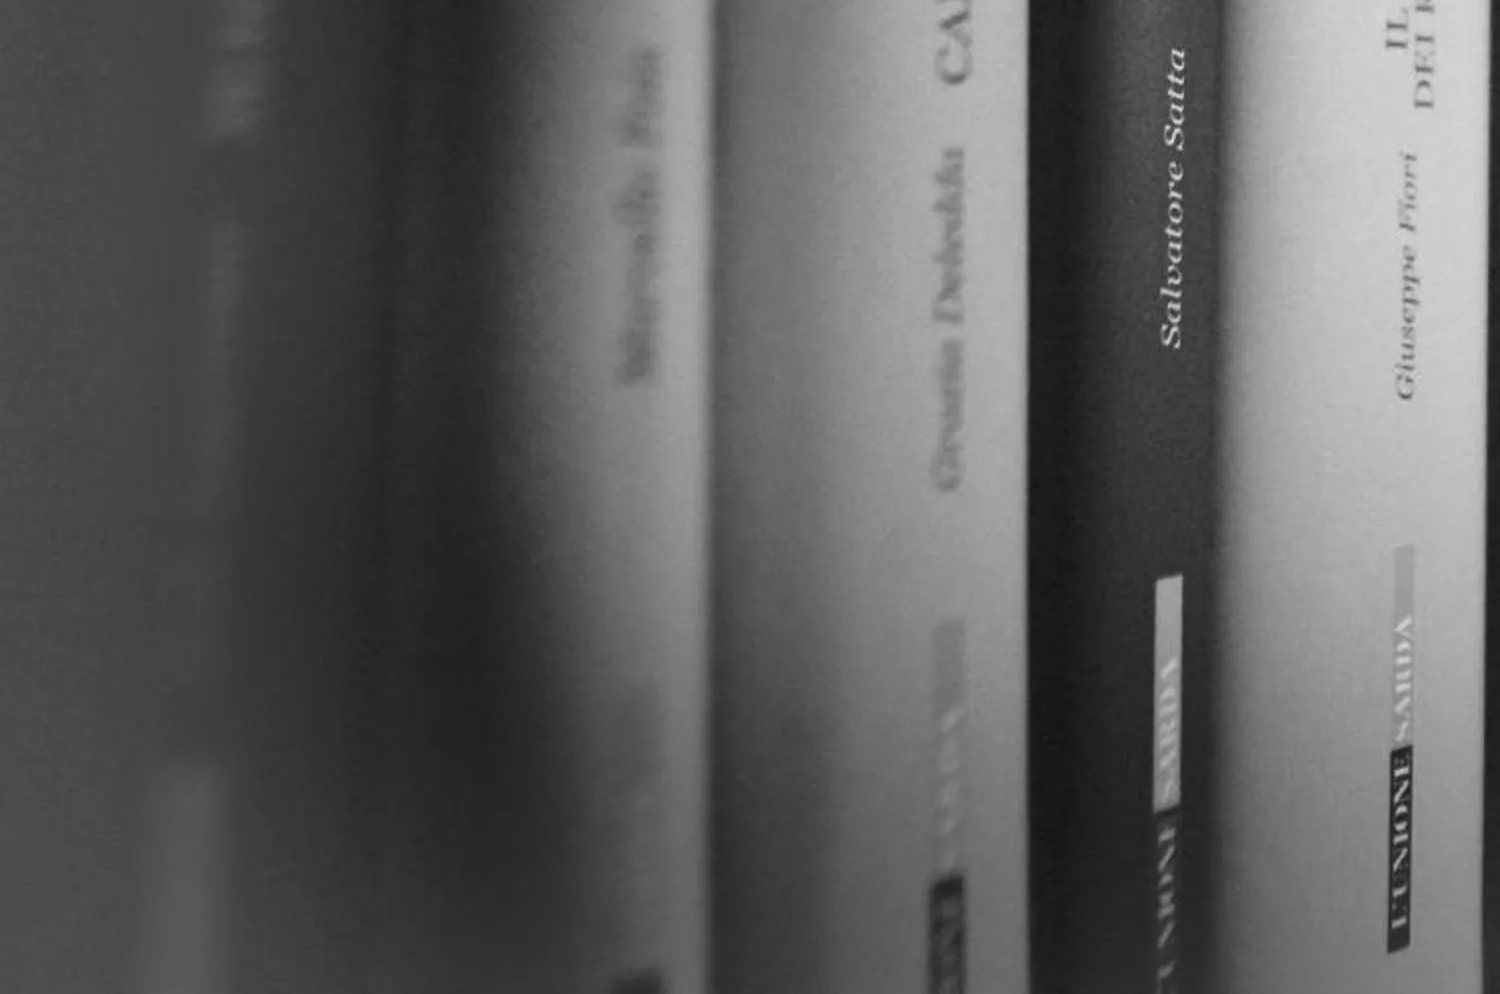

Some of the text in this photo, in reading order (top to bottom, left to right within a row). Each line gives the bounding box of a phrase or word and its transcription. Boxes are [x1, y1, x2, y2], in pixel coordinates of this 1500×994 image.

[1384, 8, 1410, 52] IL
[1412, 34, 1437, 110] DEI
[1159, 46, 1187, 350] Salvatore Satta
[1393, 150, 1421, 403] Giuseppe Fiori
